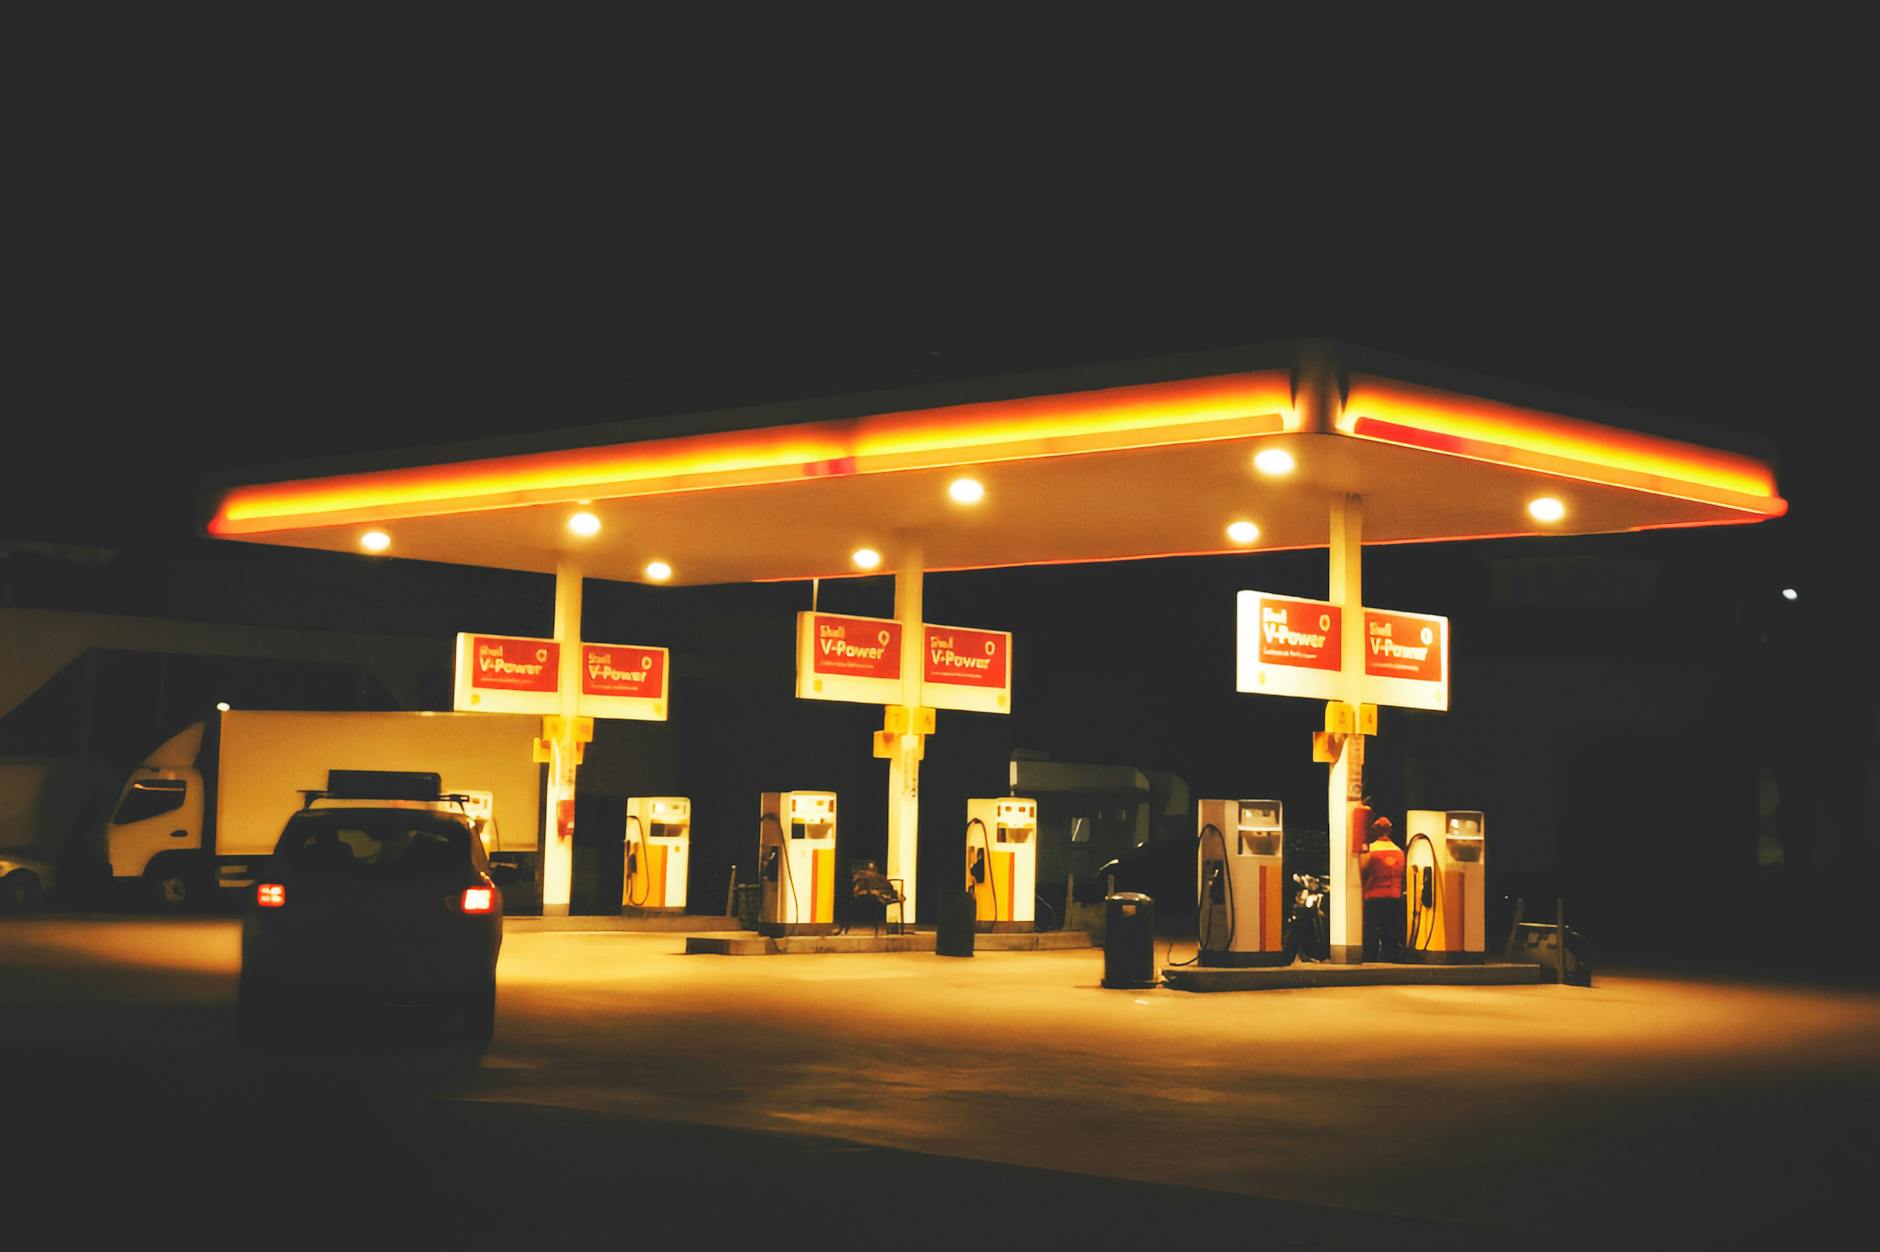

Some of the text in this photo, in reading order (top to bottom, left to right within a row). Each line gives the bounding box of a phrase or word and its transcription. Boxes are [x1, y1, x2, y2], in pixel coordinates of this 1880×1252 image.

[1263, 623, 1326, 648] V-Power
[820, 638, 885, 660] V-Power
[479, 657, 543, 675] V-Power
[931, 650, 991, 670] V-Power
